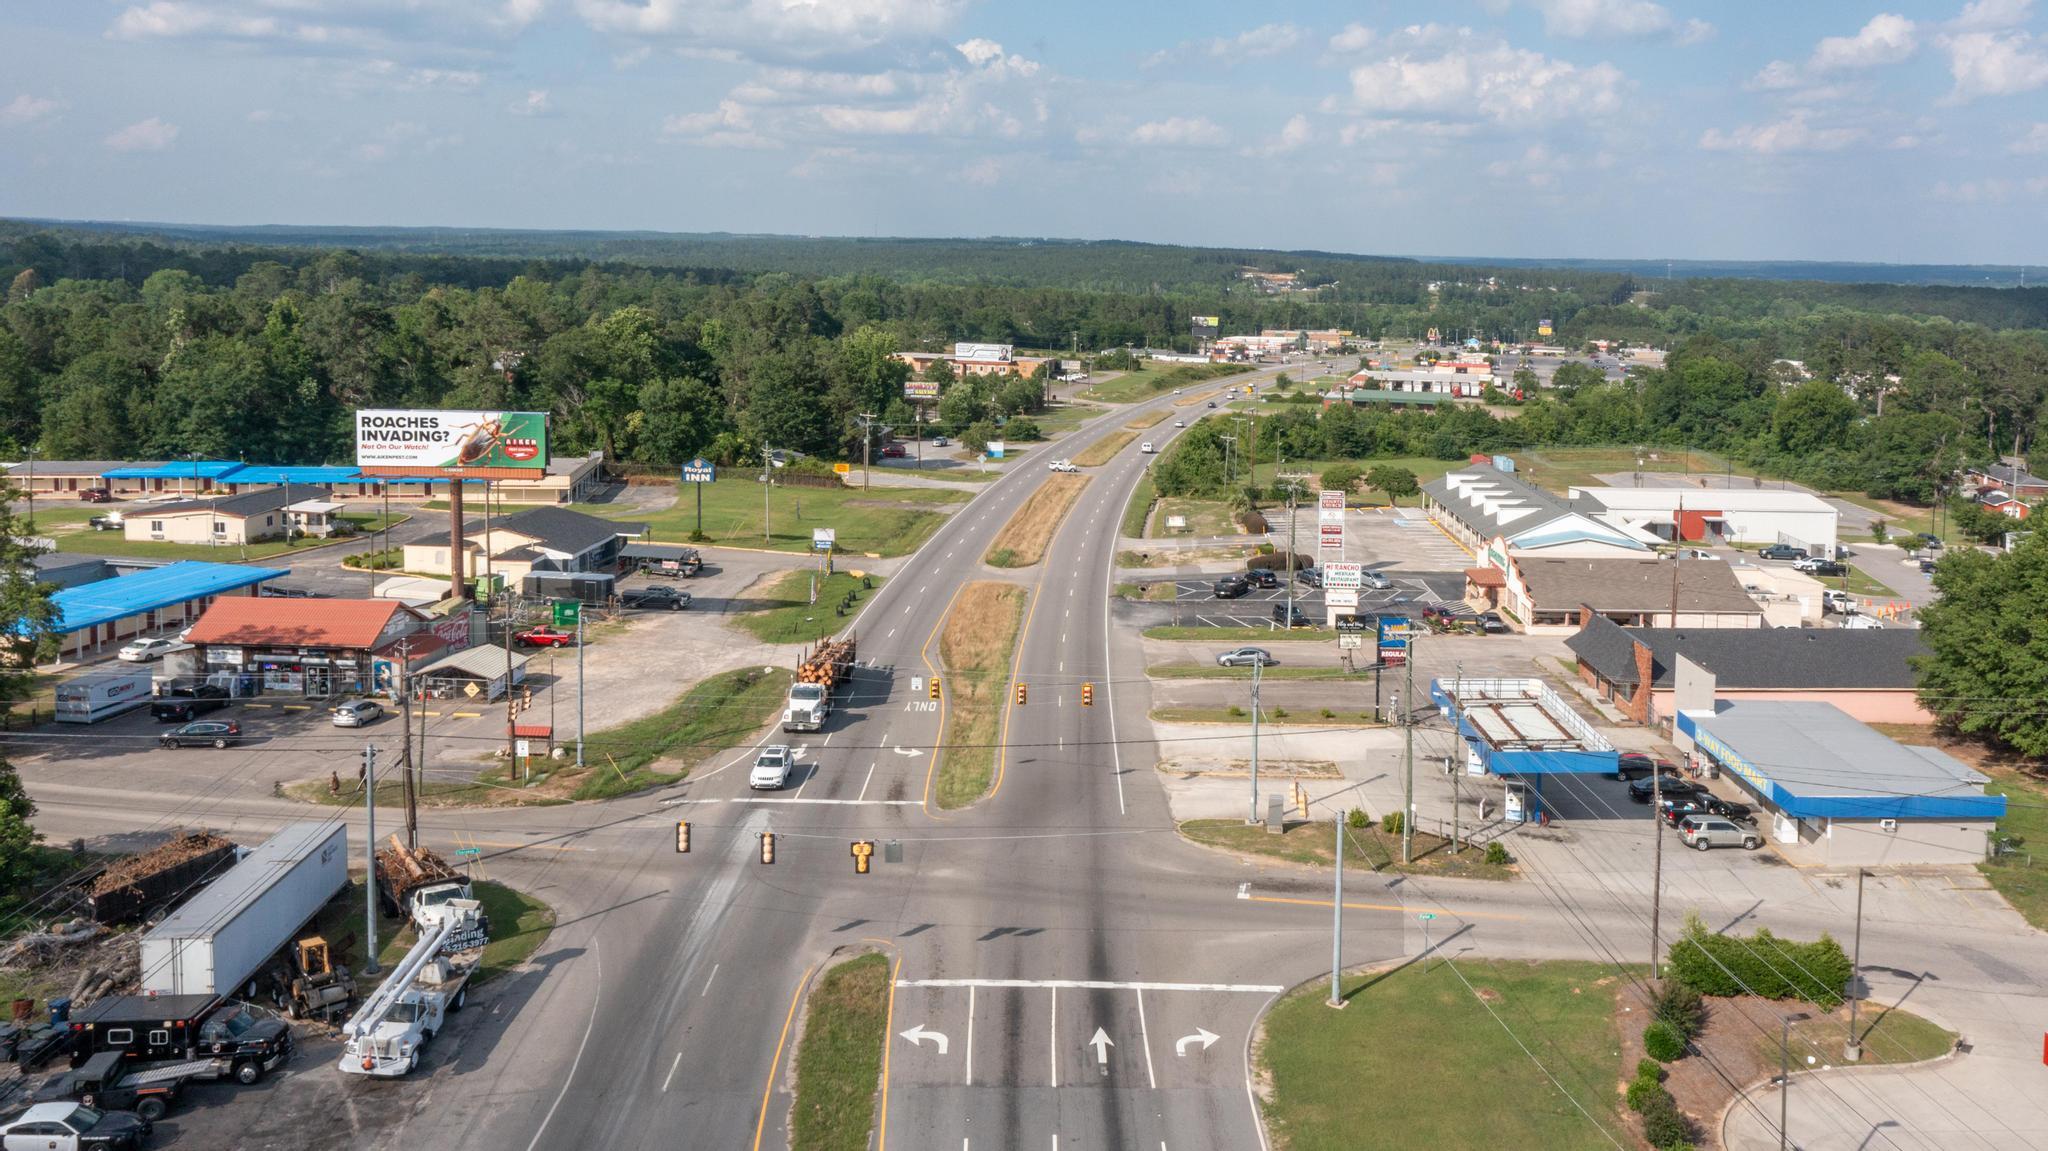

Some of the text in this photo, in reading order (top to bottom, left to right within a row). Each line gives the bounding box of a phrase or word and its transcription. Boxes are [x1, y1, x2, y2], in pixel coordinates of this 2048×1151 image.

[361, 416, 439, 428] ROACHES
[361, 430, 450, 442] INVADING?
[505, 438, 537, 446] AIKEN
[684, 466, 712, 474] Royal
[685, 474, 711, 482] INN
[904, 701, 937, 712] ONLY
[1721, 747, 1742, 772] FOOD
[1744, 765, 1768, 791] MART
[449, 928, 484, 942] inding
[444, 936, 489, 952] -215-3977
